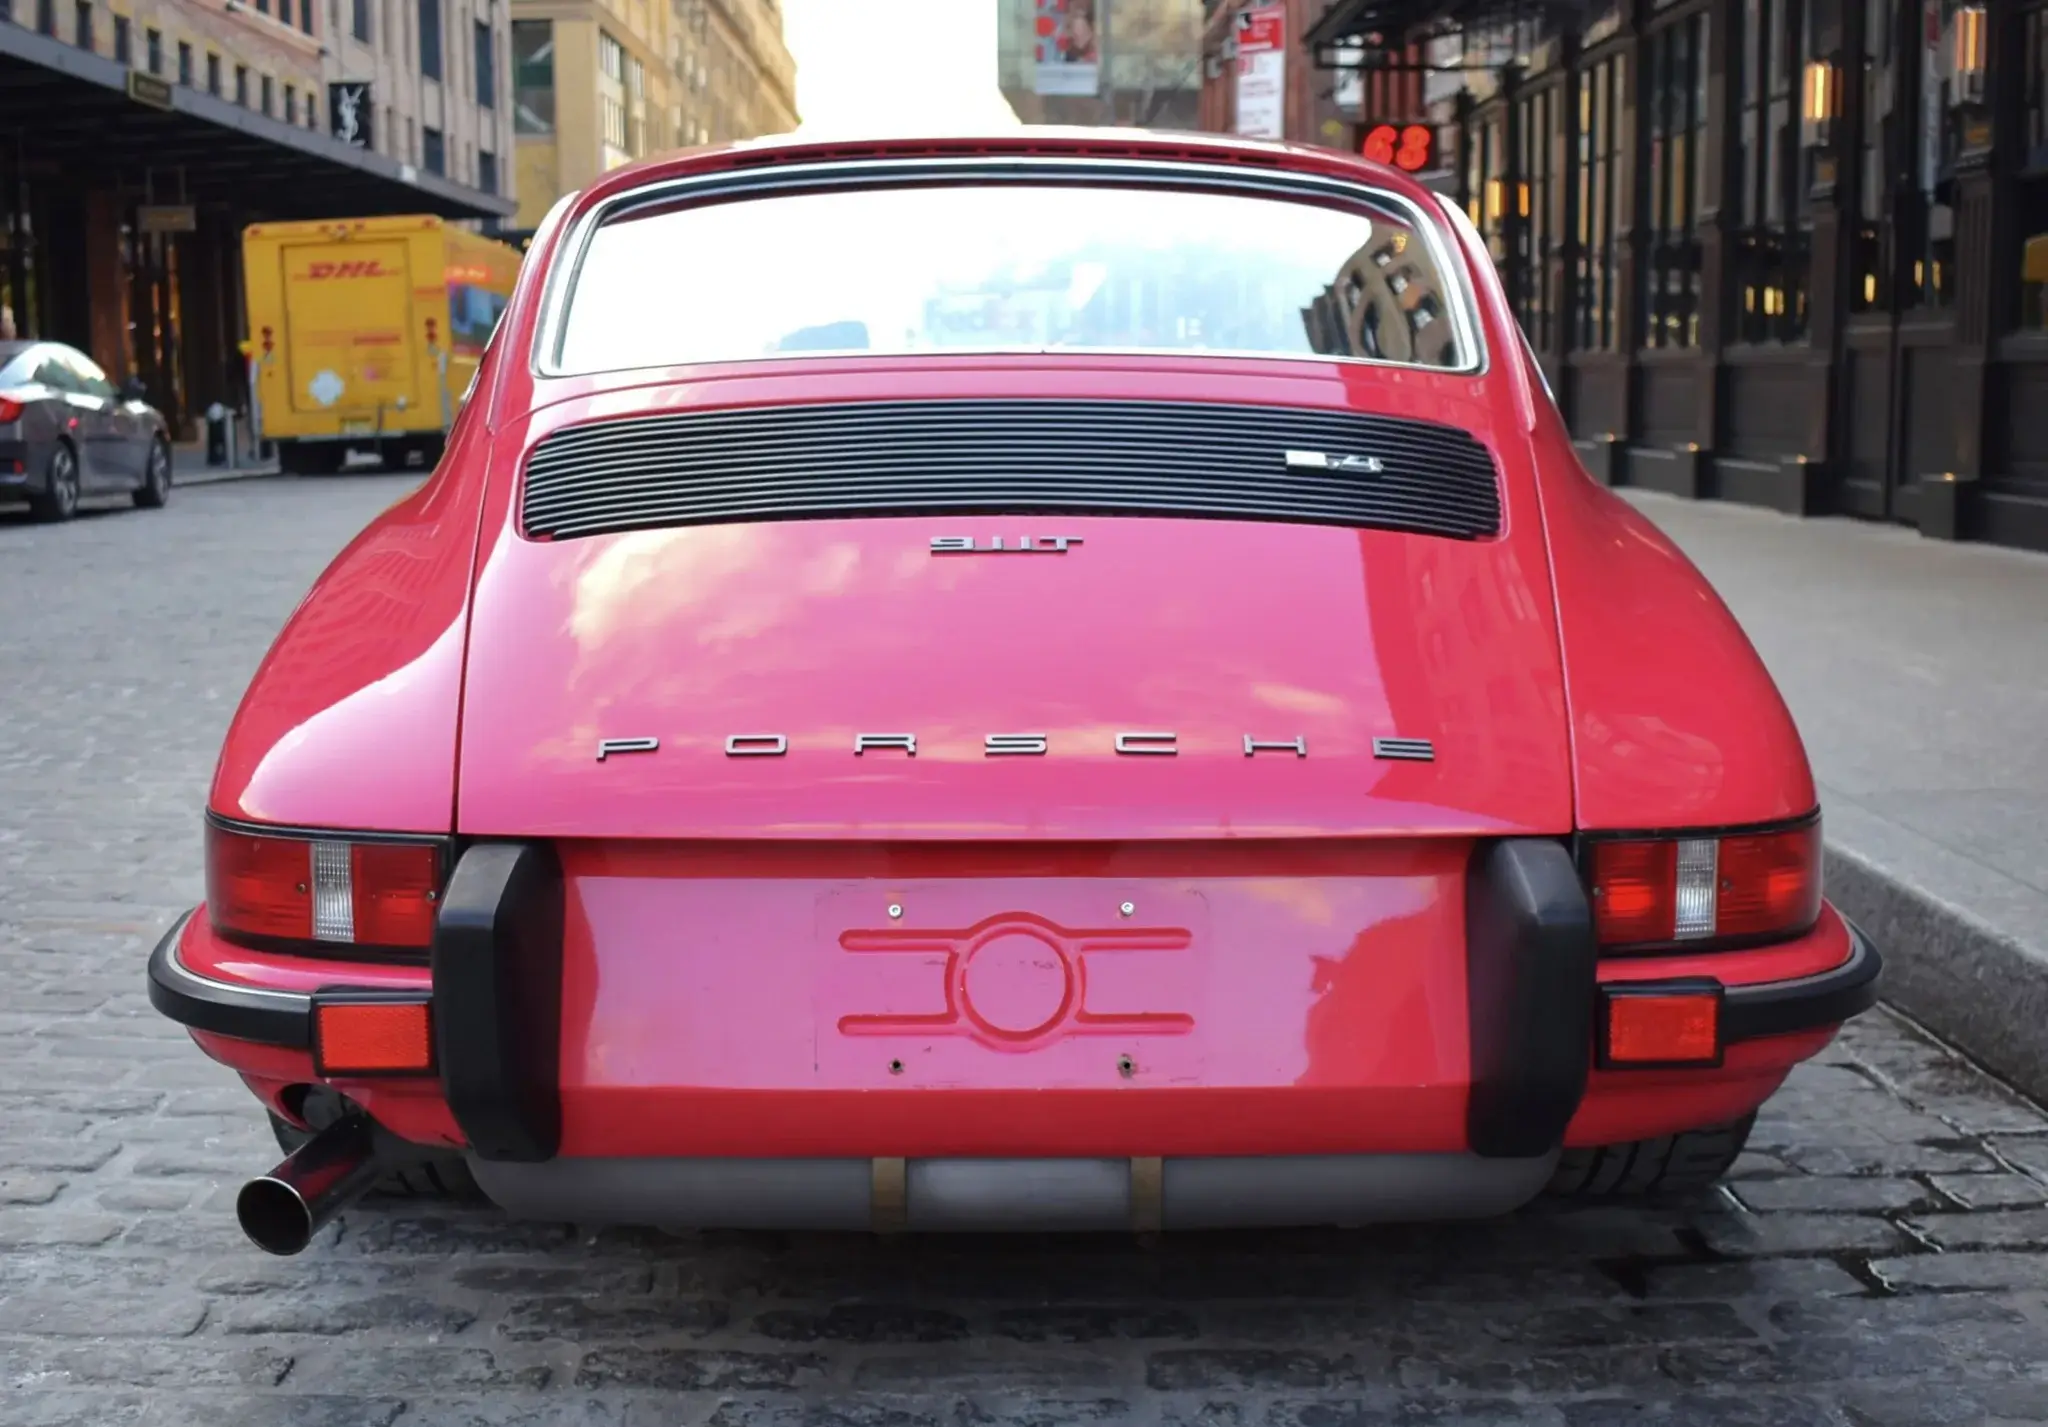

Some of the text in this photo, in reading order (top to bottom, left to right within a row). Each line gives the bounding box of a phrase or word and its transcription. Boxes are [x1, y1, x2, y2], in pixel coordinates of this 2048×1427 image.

[308, 260, 386, 279] DHL
[930, 535, 1084, 554] 911T
[596, 732, 1436, 762] PORSCHE
